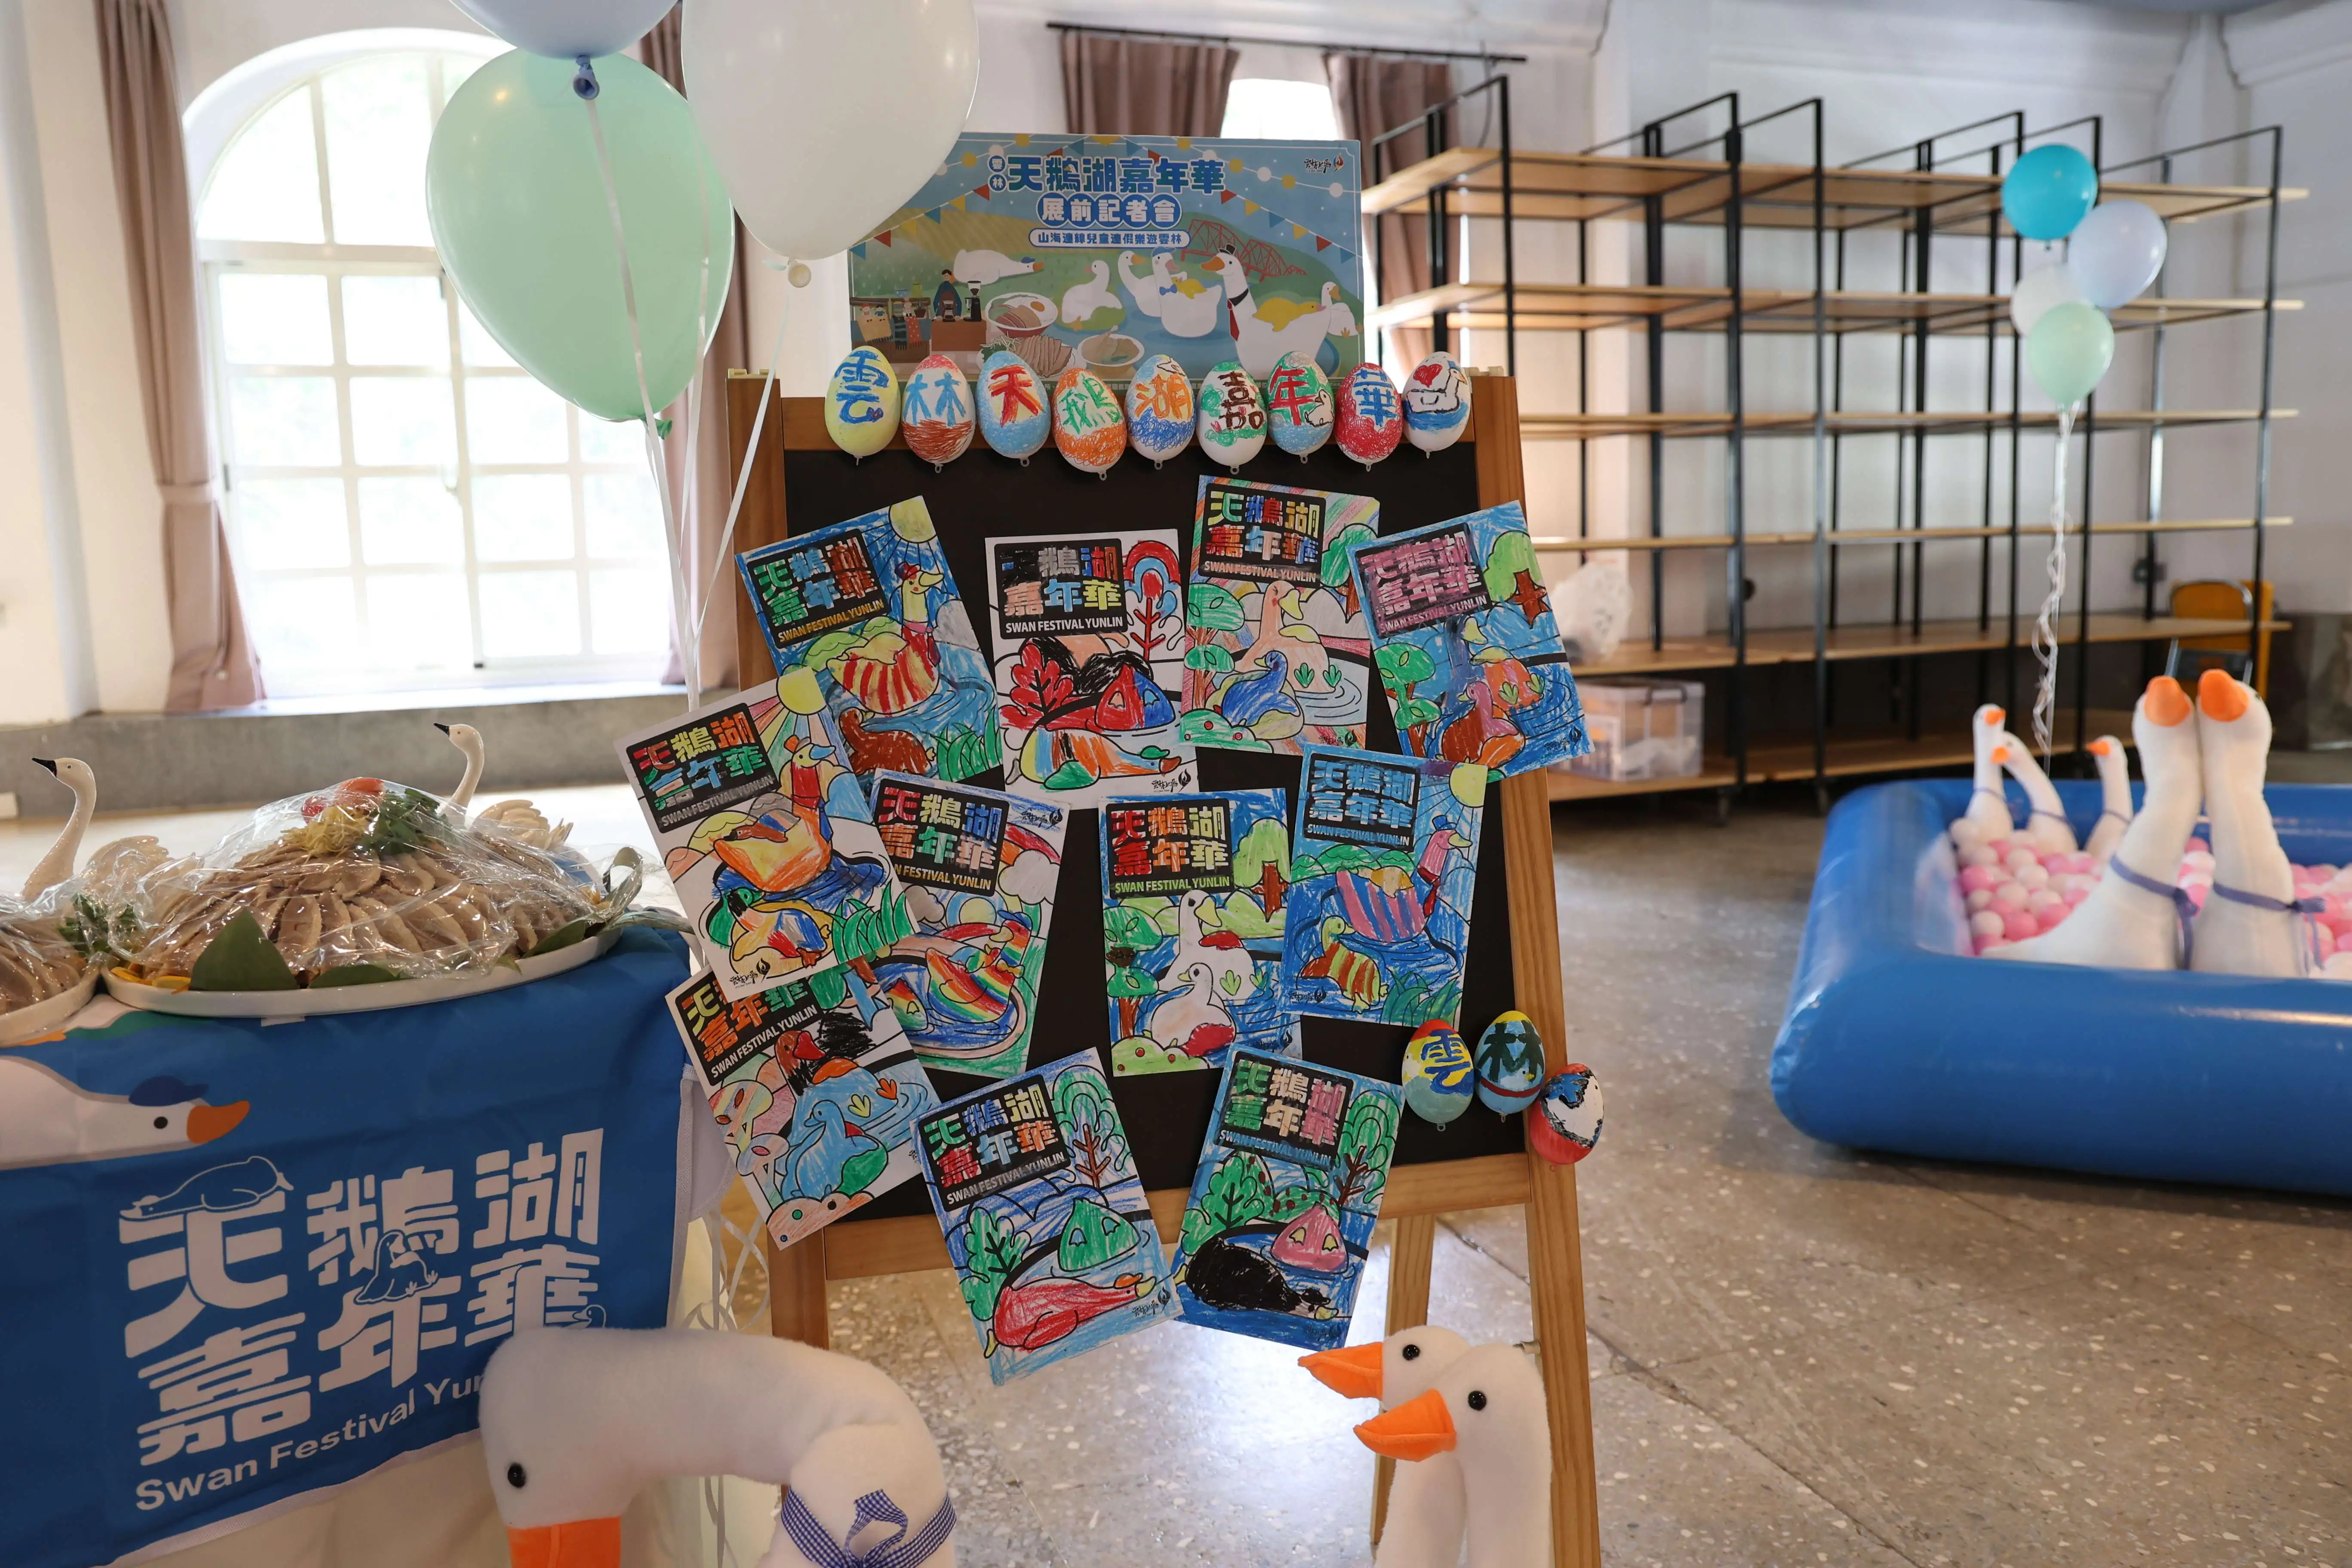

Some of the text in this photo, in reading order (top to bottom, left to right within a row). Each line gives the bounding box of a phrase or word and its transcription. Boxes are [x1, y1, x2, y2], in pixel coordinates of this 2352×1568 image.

[1008, 156, 1225, 193] 天鵝湖嘉年華
[1041, 198, 1176, 223] 展前記者會
[1038, 232, 1182, 245] 山海連線兒童連假樂遊雲林
[834, 350, 888, 423] 雲
[903, 371, 966, 426] 林
[989, 365, 1045, 427] 天
[1134, 374, 1192, 420] 湖
[1268, 366, 1318, 425] 年
[1354, 368, 1397, 426] 華
[1207, 491, 1320, 539] 天鵝湖
[1206, 524, 1318, 564] 嘉年華
[753, 537, 868, 601] 天鵝湖
[1204, 561, 1316, 582] SWAN FESTIVAL YUNLIN
[767, 570, 878, 627] 嘉年華
[1004, 579, 1121, 616] 嘉年華
[1450, 595, 1487, 612] YUNLIN
[778, 599, 885, 643] SWAN FESTIVAL YUNLIN
[1006, 616, 1123, 633] SWAN FESTIVAL YUNLIN
[633, 712, 755, 785] 天鵝湖
[661, 775, 774, 826] SWAN FESTIVAL YUNLIN
[1311, 760, 1415, 805] 天鵝湖
[879, 787, 1002, 843] 天鵝湖
[1111, 806, 1225, 848] 天鵝湖
[1309, 791, 1413, 828] 嘉年華
[1307, 824, 1409, 846] SWAN FESTIVAL YUNLIN
[903, 866, 950, 883] FESTIVAL
[952, 873, 991, 890] YUNLIN
[1114, 839, 1228, 876] 嘉年華
[1115, 876, 1229, 893] SWAN FESTIVAL YUNLIN
[711, 1004, 818, 1078] SWAN FESTIVAL YUNLIN
[1421, 1029, 1474, 1095] 雲
[924, 1084, 1049, 1160] 天鵝湖
[1219, 1130, 1246, 1144] SWAN
[937, 1121, 1059, 1188] 嘉年華
[947, 1152, 1065, 1204] SWAN FESTIVAL YUNLIN
[119, 1128, 603, 1358] 天鵝湖
[135, 1460, 257, 1511] Swan
[270, 1388, 415, 1470] Festival
